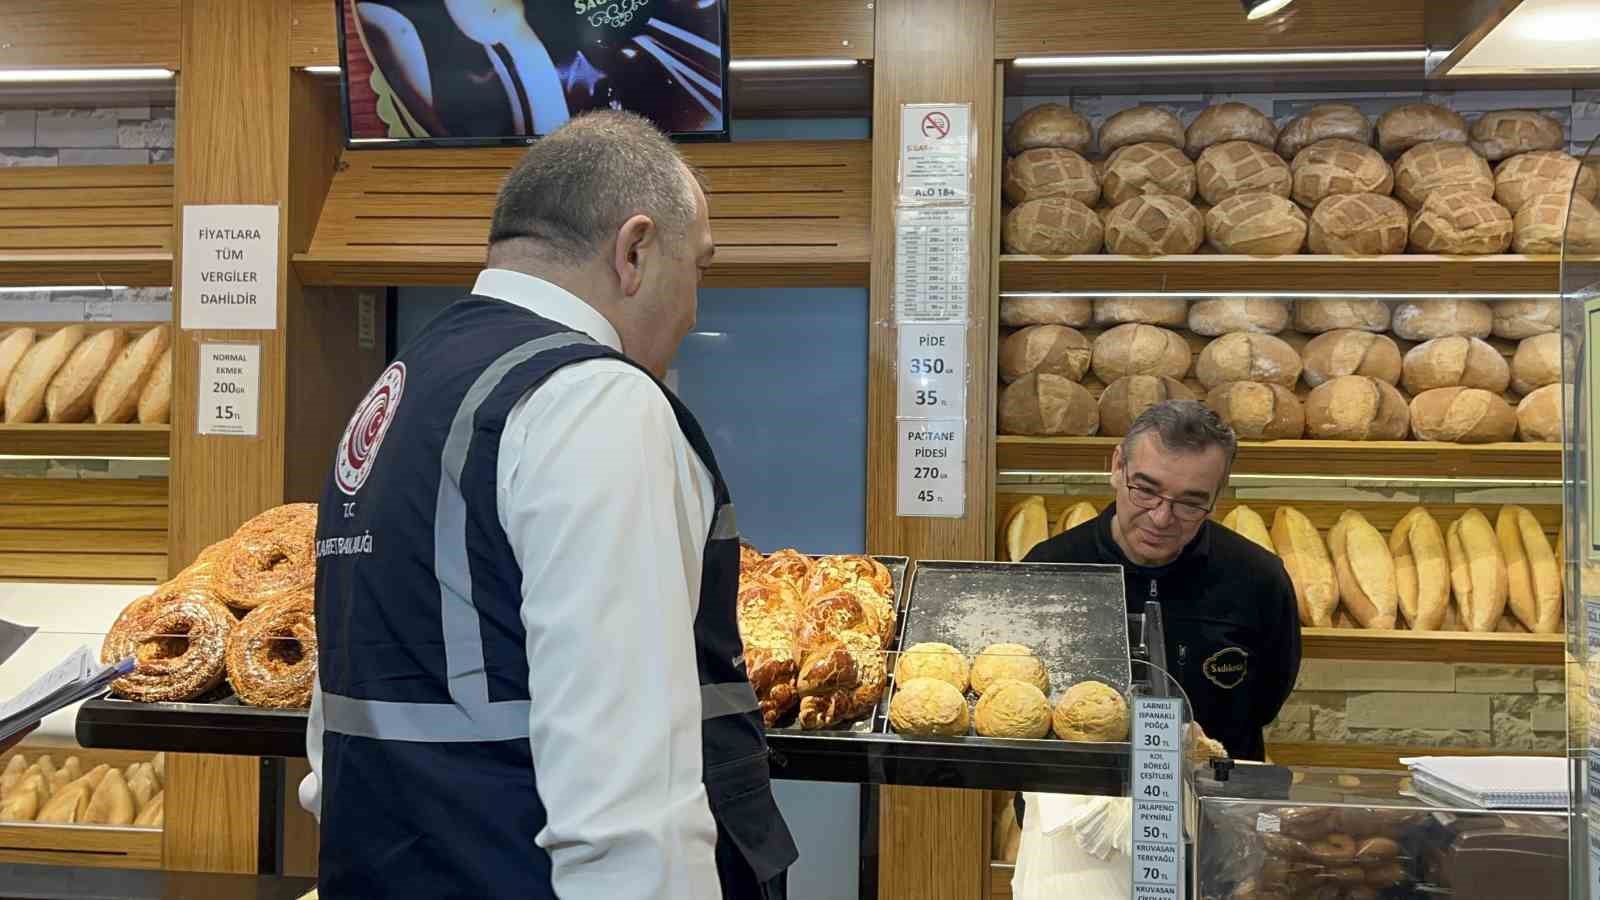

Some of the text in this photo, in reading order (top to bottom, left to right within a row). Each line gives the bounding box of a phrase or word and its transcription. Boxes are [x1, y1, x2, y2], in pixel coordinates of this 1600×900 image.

[199, 227, 261, 240] FİYATLARA
[216, 247, 243, 260] TÜM
[201, 270, 257, 282] VERGİLER
[200, 292, 257, 304] DAHİLDİR
[919, 334, 945, 346] PİDE
[910, 358, 944, 374] 350
[915, 390, 938, 405] 35
[908, 431, 954, 441] PASTANE
[914, 447, 947, 458] PİDESİ
[913, 466, 939, 479] 270
[917, 489, 935, 502] 45
[1142, 702, 1172, 710] LABNELİ
[1144, 734, 1161, 746] 30
[1143, 761, 1170, 770] BÖREĞİ
[1143, 784, 1161, 797] 40
[1143, 826, 1161, 839] 50
[1136, 845, 1176, 853] KRUVASAN
[1137, 853, 1175, 863] TEREYAĞLI
[1143, 867, 1160, 880] 70
[1135, 886, 1175, 895] KRUVASAN
